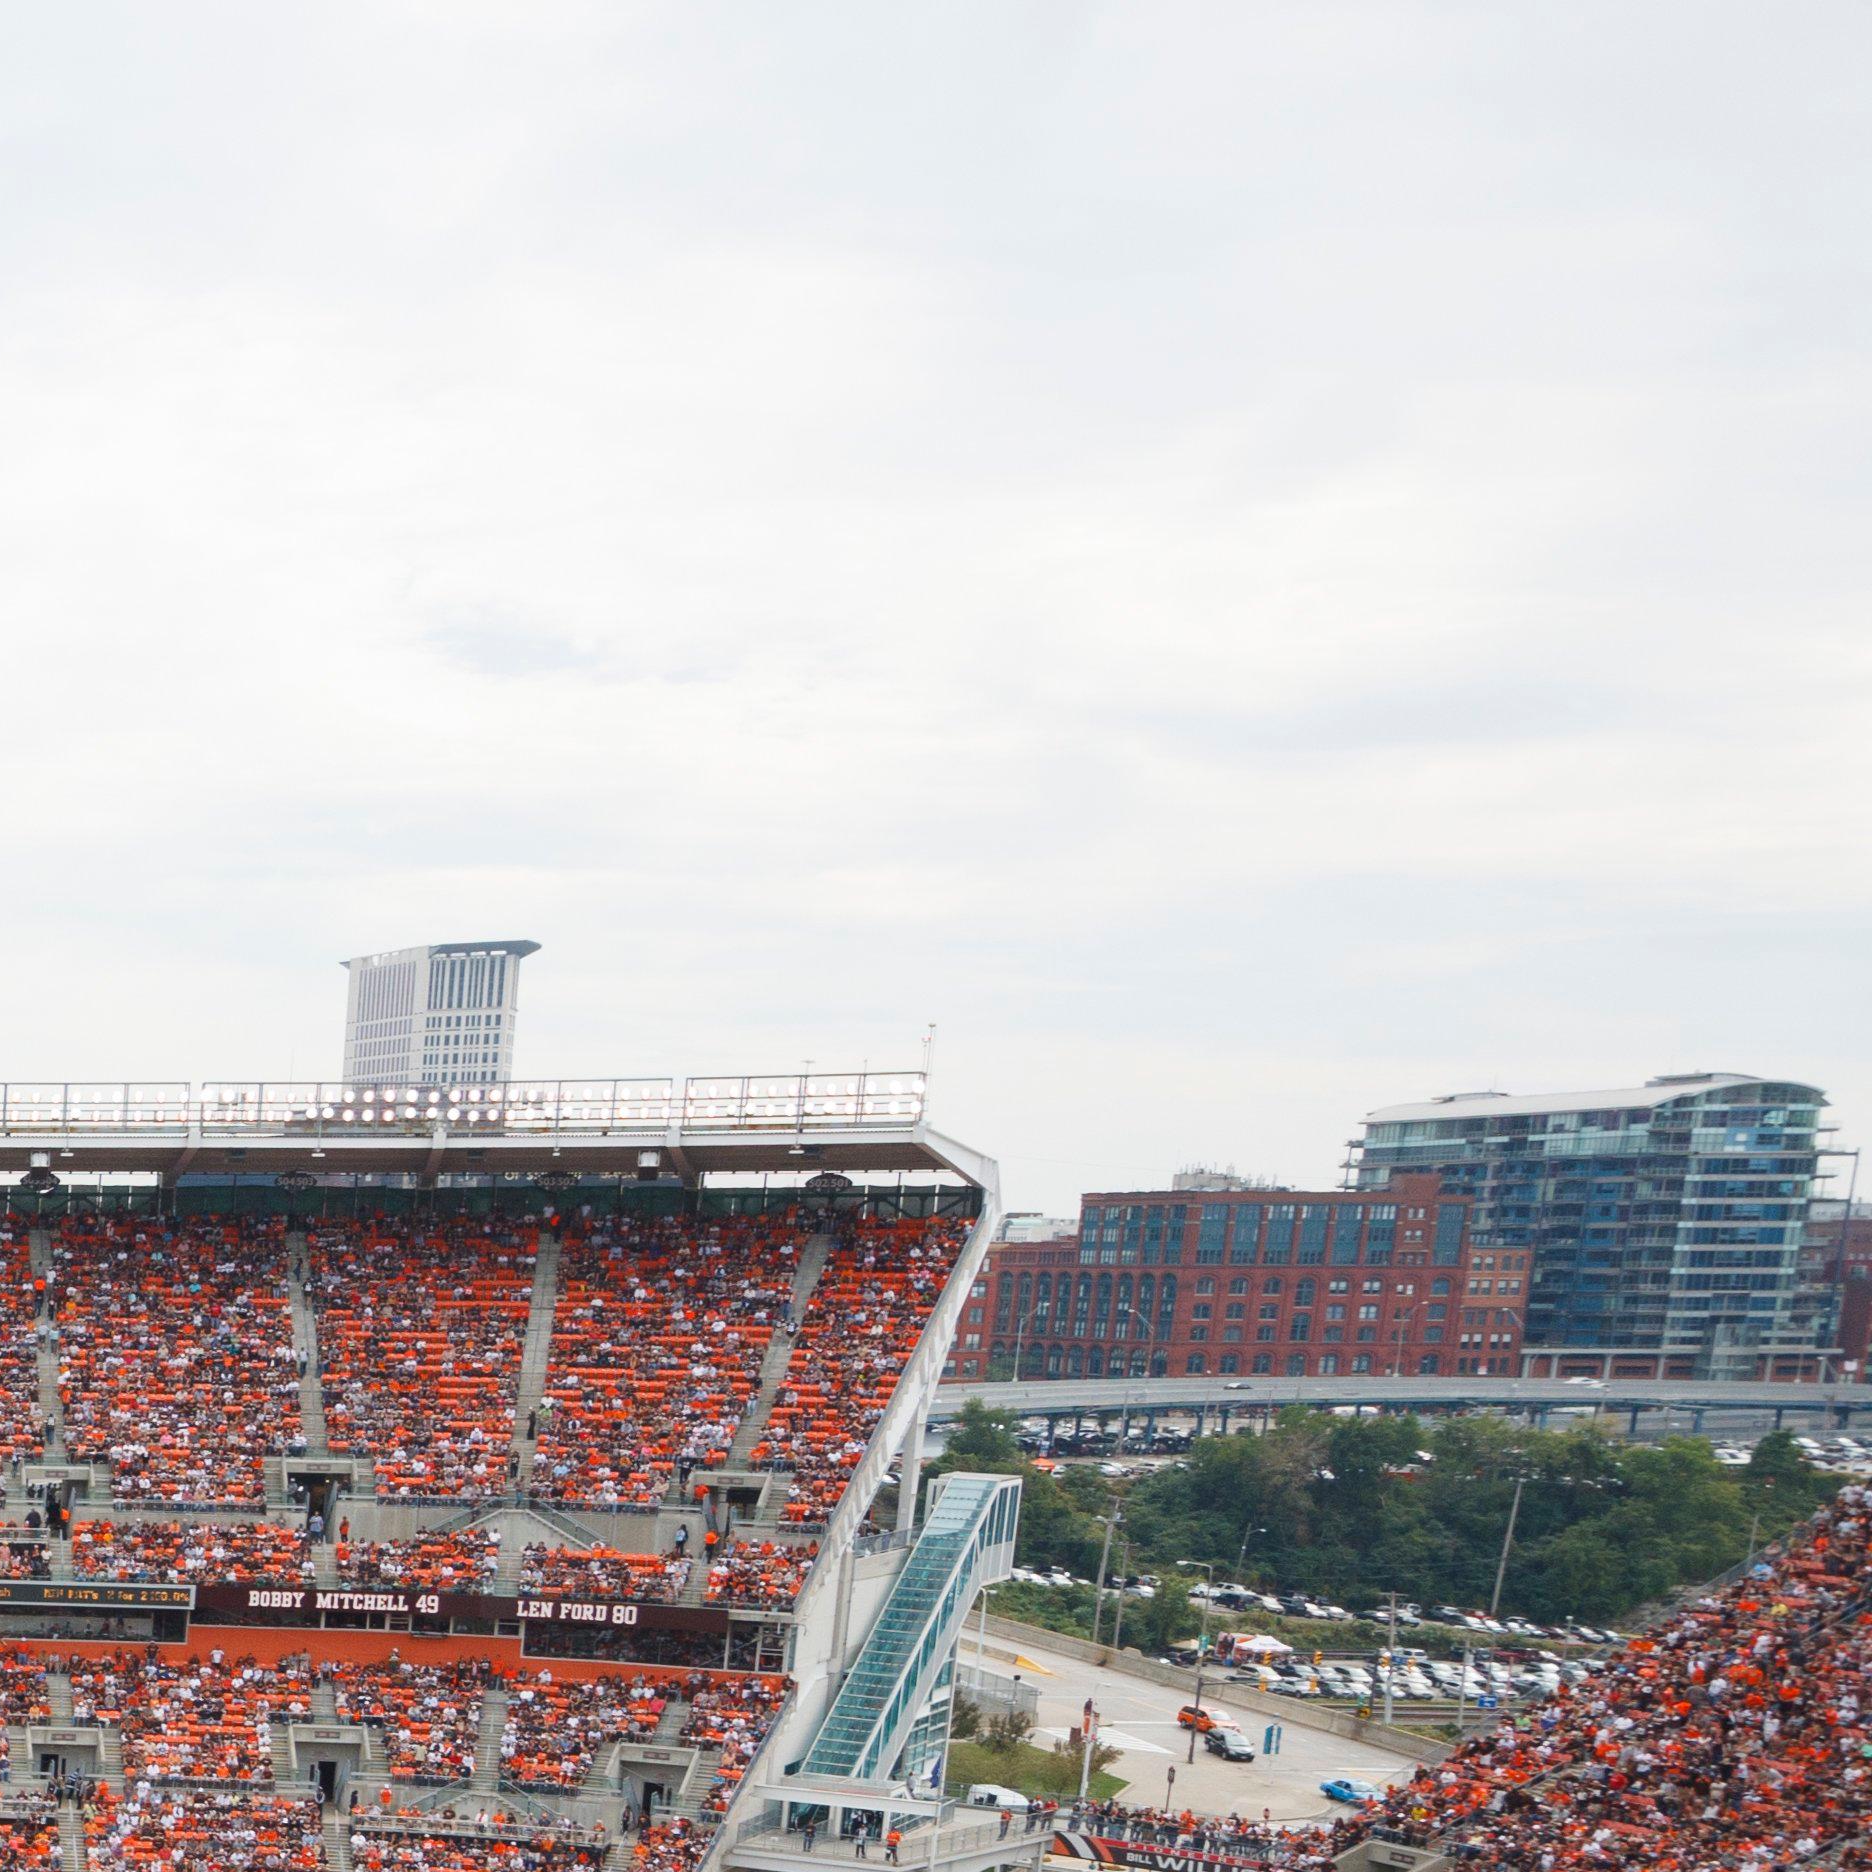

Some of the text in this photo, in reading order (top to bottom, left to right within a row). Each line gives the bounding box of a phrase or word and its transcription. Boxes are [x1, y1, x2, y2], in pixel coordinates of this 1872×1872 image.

[249, 1591, 440, 1613] BOBBY MITCHELL 49
[516, 1601, 638, 1624] LEN FORD 80
[1126, 1852, 1153, 1865] BILL
